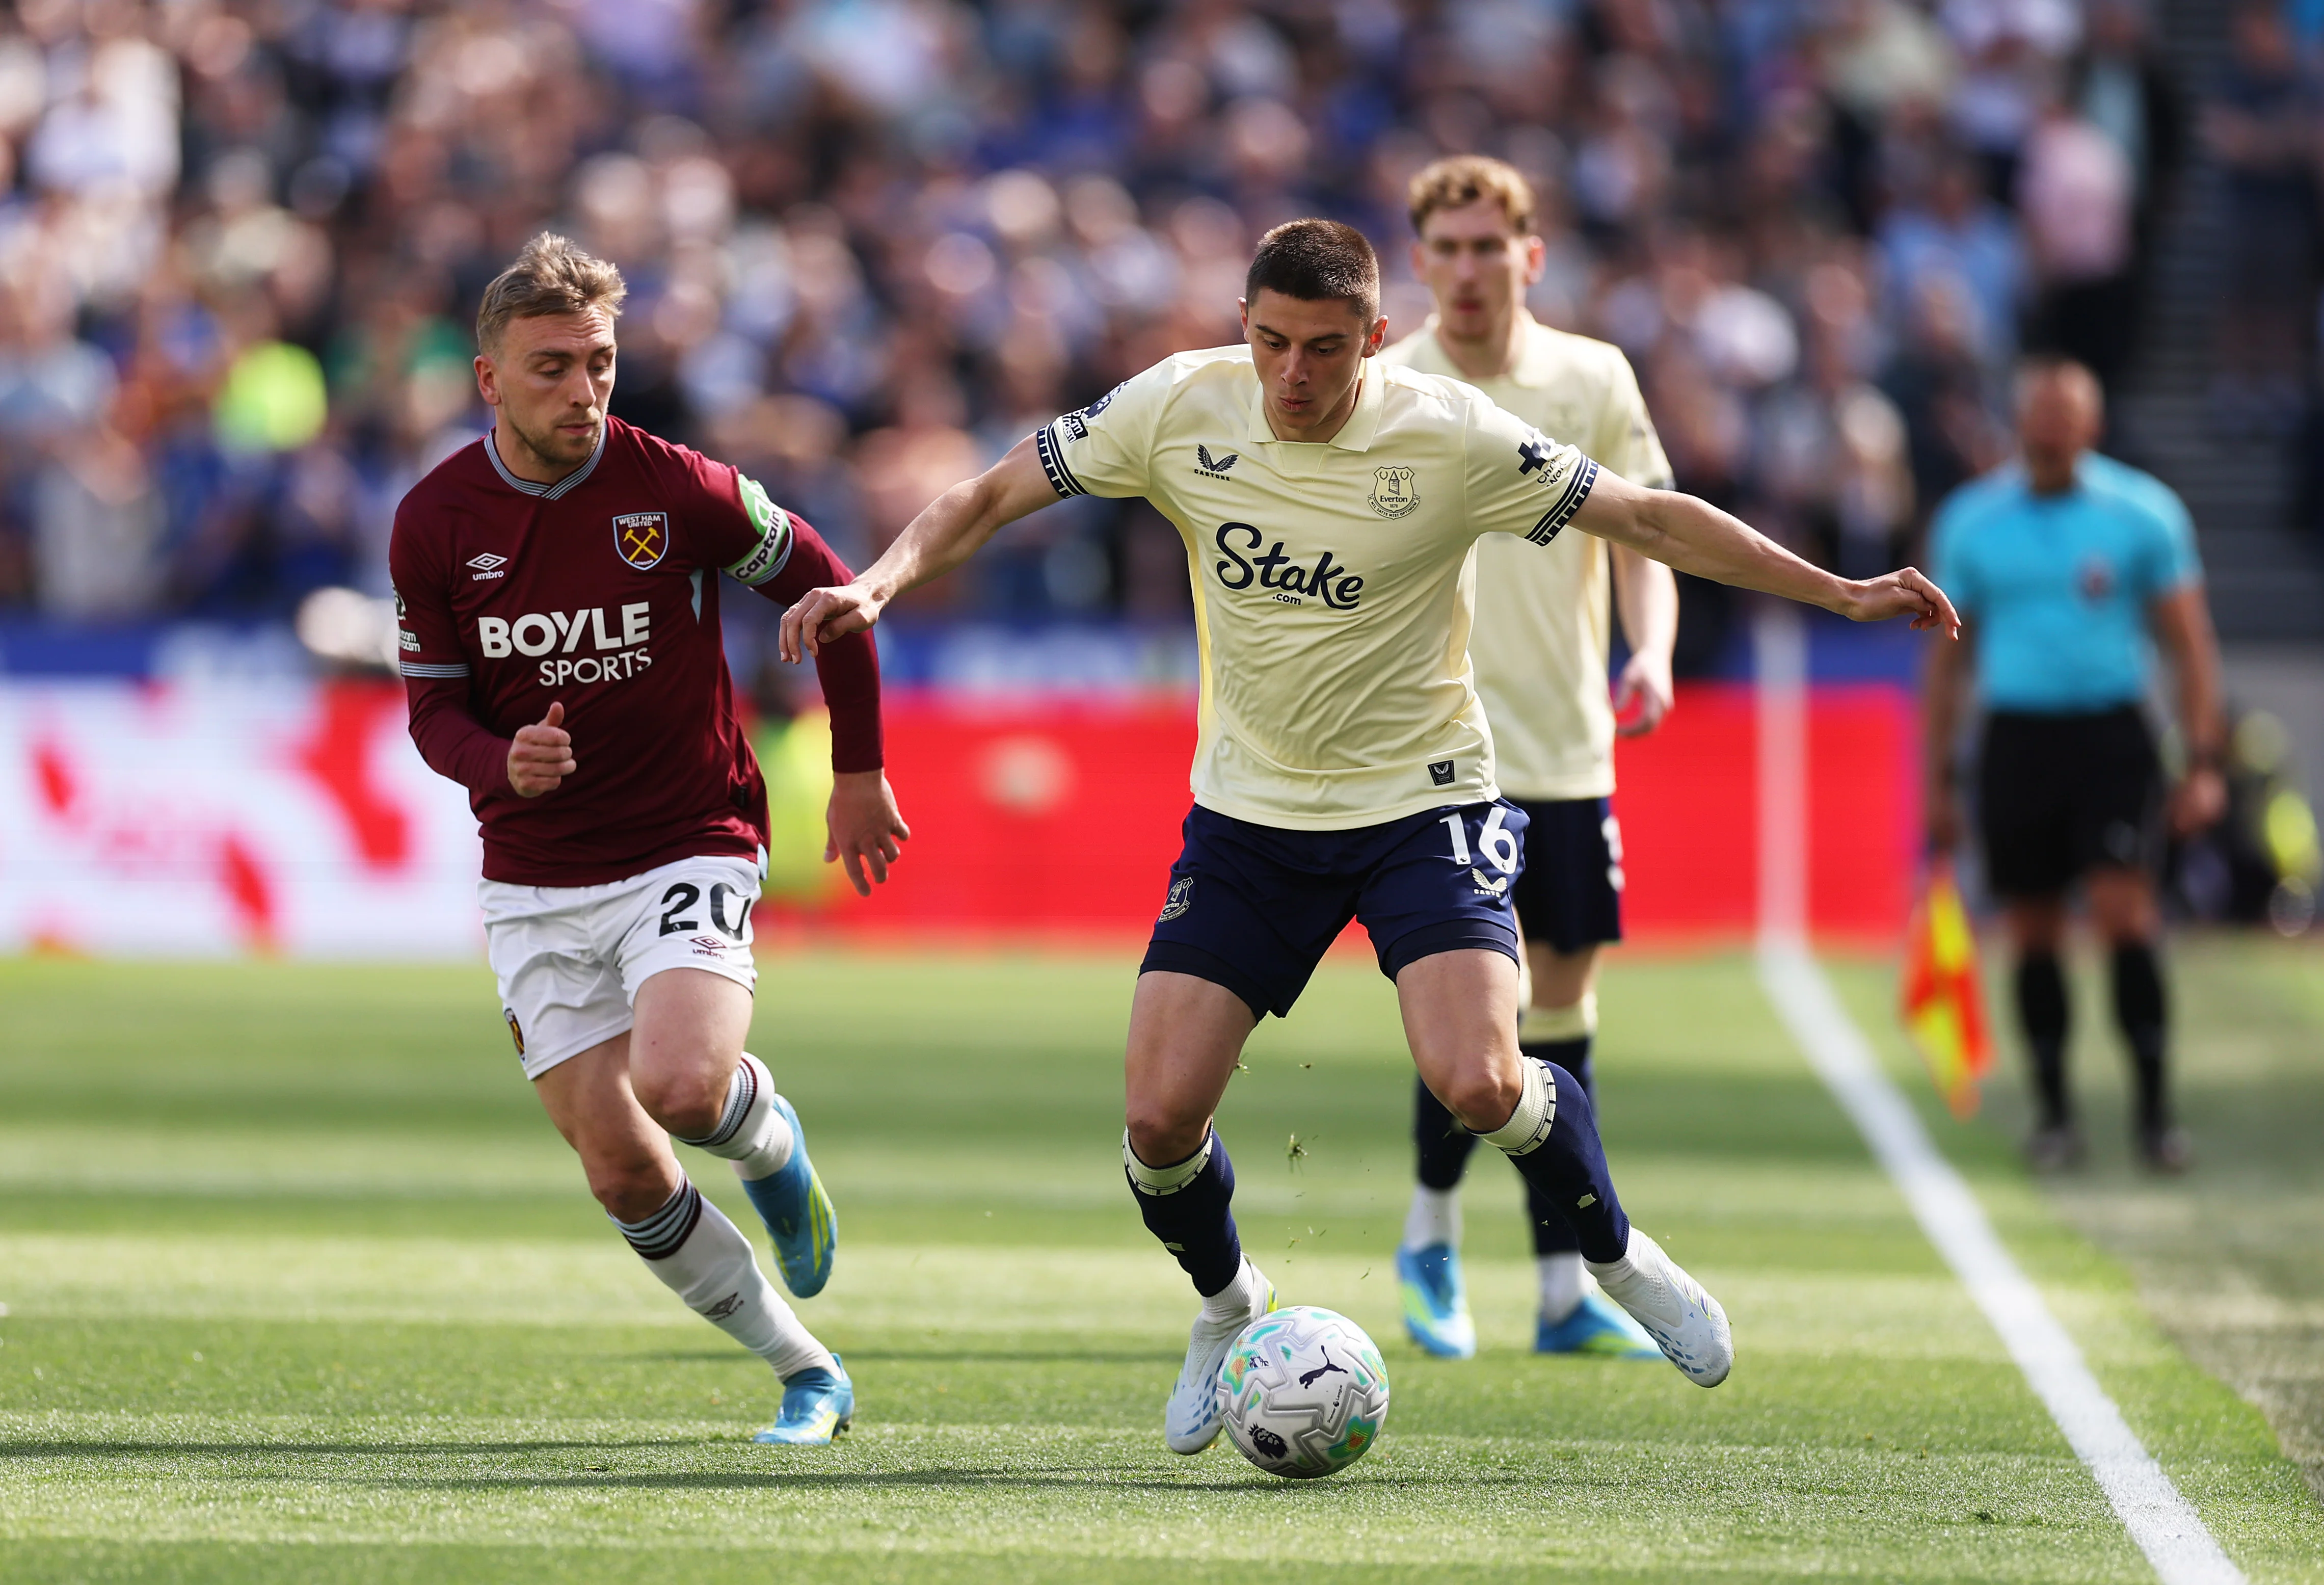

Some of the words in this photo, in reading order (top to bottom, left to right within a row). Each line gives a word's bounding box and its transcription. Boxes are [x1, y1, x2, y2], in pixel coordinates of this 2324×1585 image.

[1194, 469, 1230, 481] CASTORE
[618, 515, 640, 525] WEST
[1377, 508, 1387, 516] SATIS
[1400, 501, 1417, 516] OPTIMUM
[735, 511, 780, 579] Captain
[472, 570, 504, 581] umbro
[1216, 522, 1364, 610] Stake
[1272, 593, 1301, 605] .com
[478, 601, 650, 658] BOYLE
[539, 647, 652, 686] SPORTS
[1439, 807, 1518, 874] 16
[659, 882, 751, 941] 20
[692, 948, 725, 959] umbro
